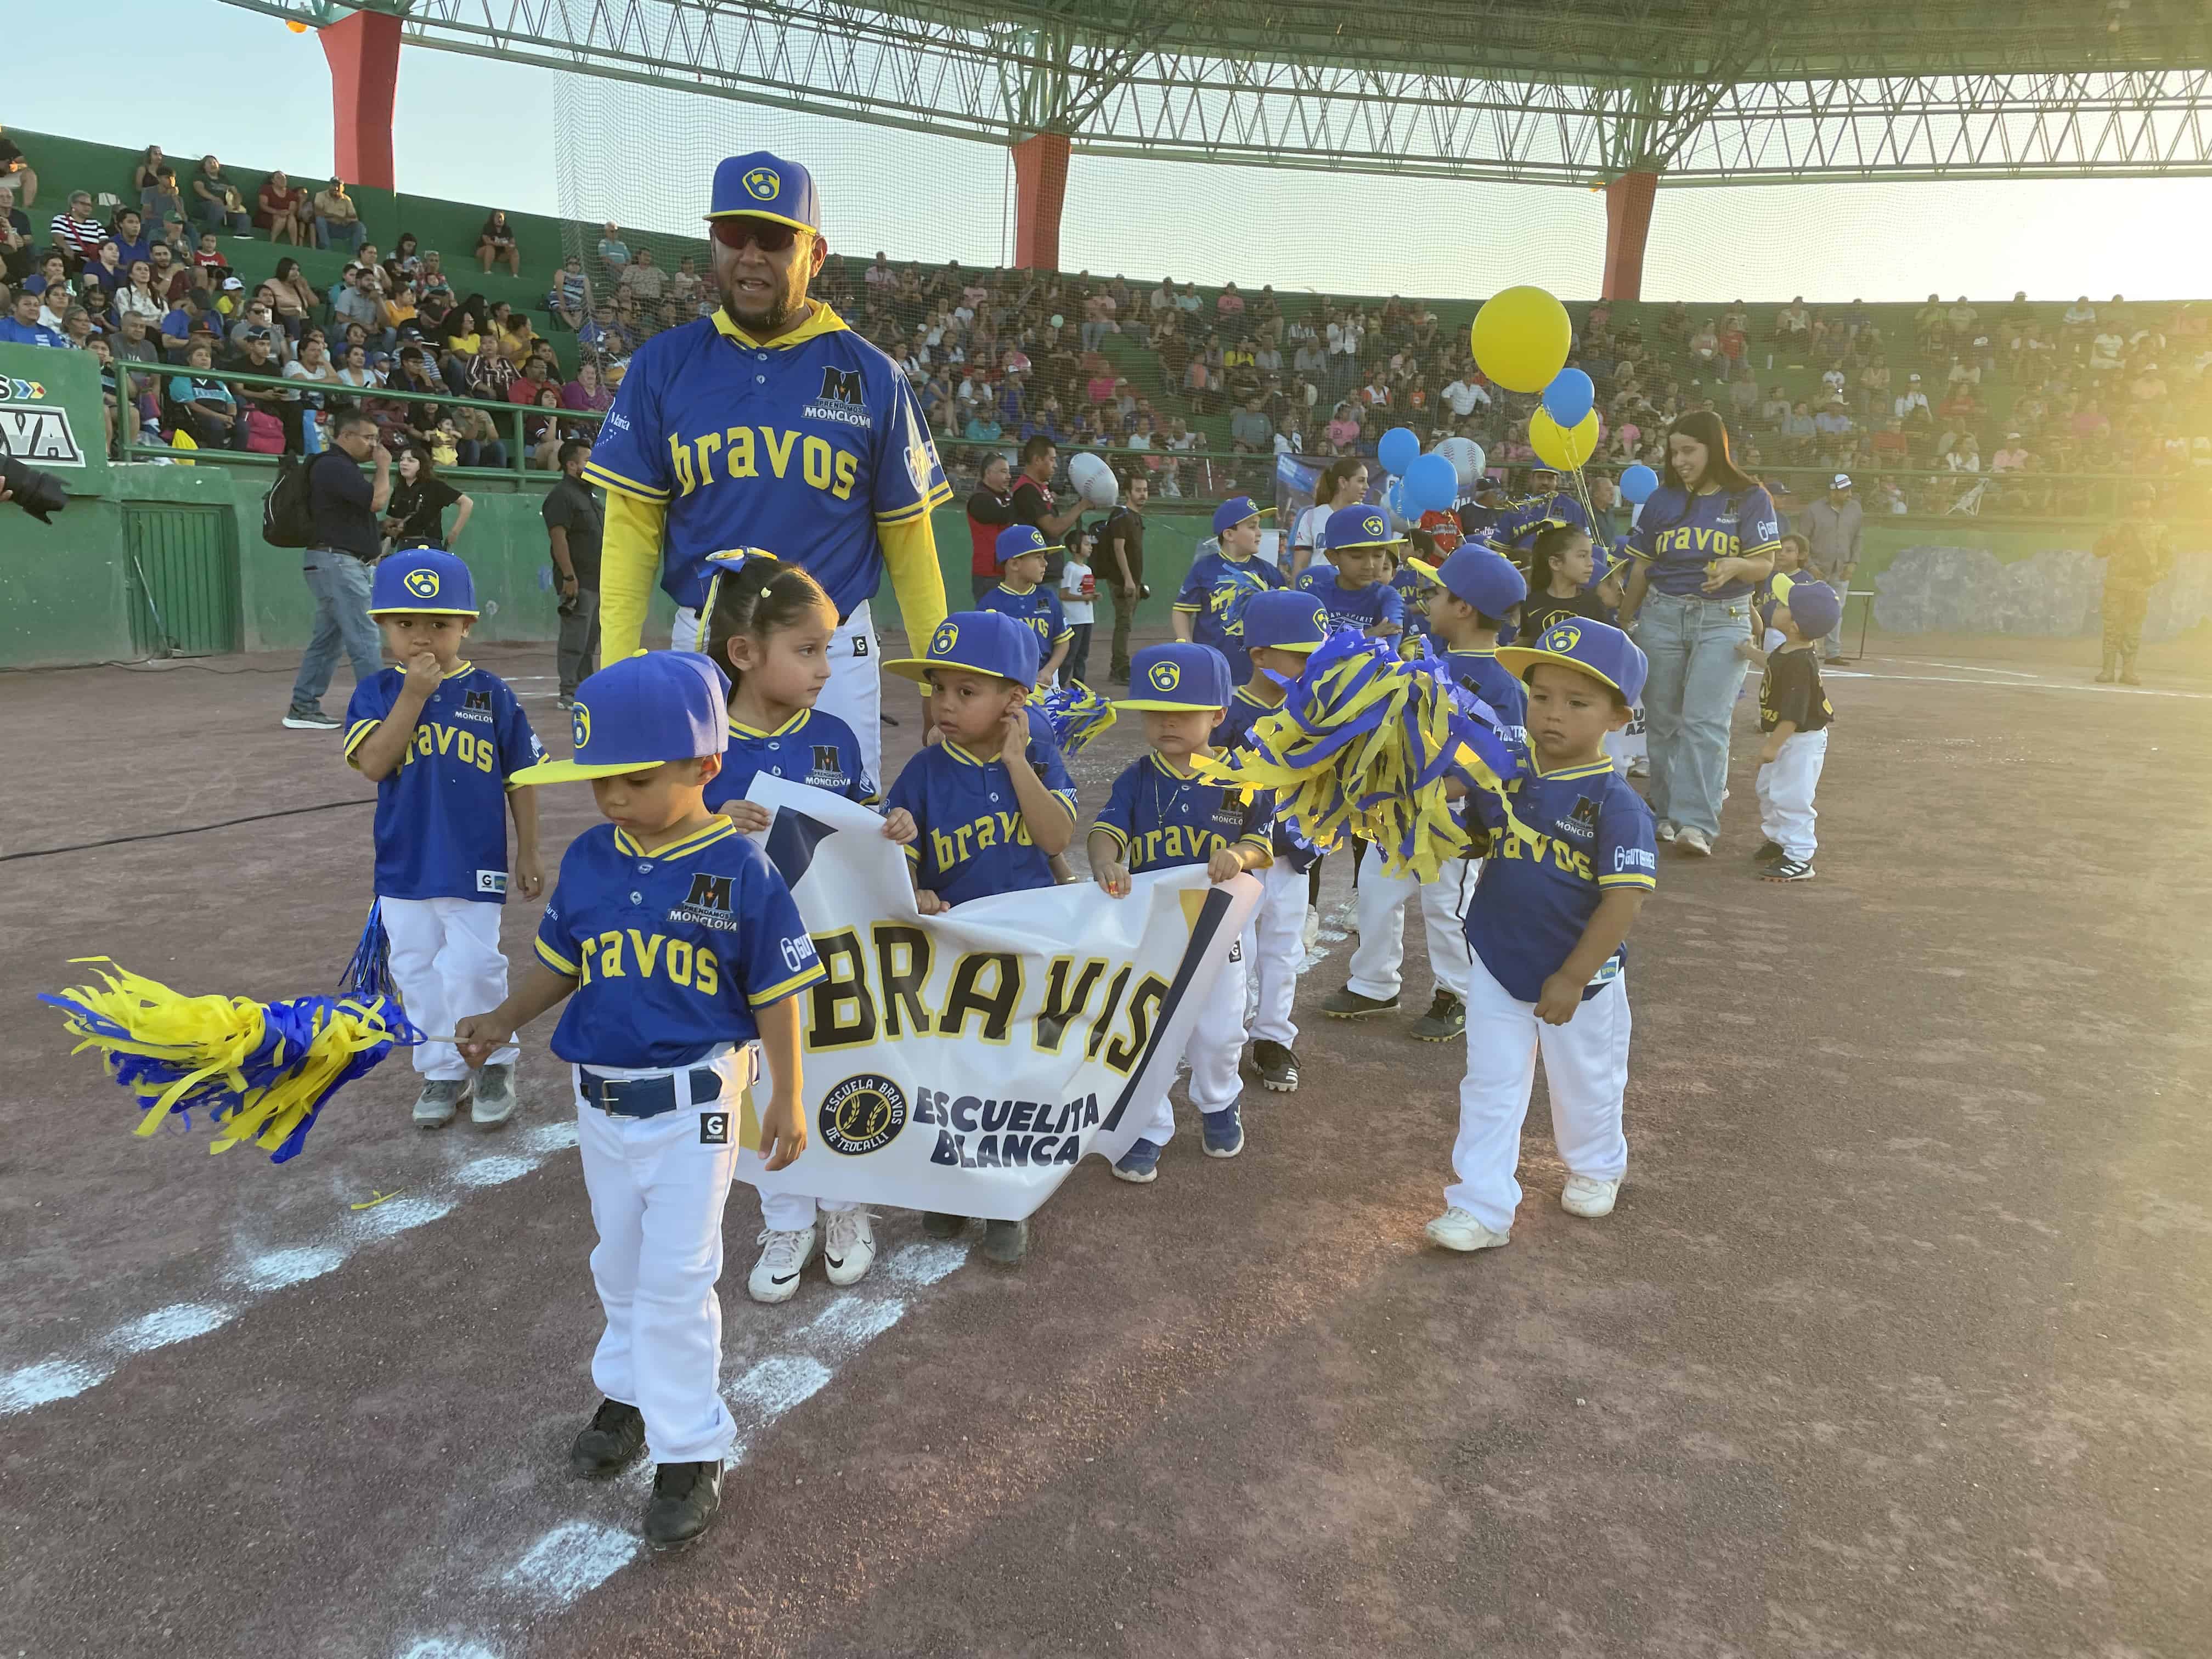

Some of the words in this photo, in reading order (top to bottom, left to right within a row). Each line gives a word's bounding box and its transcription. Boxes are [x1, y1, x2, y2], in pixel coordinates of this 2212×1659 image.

[668, 426, 859, 500] bravos
[399, 721, 494, 775] ravos
[1486, 824, 1594, 881] ravos
[669, 910, 738, 932] MONCLOVA
[579, 929, 719, 996] ravos
[825, 1079, 874, 1113] ESCUELA
[878, 1082, 904, 1125] BRAVOS
[912, 1086, 1099, 1133] ESCUELITA
[825, 1126, 840, 1143] DE
[837, 1132, 889, 1152] TEOCALLI
[930, 1129, 1080, 1168] BLANCA
